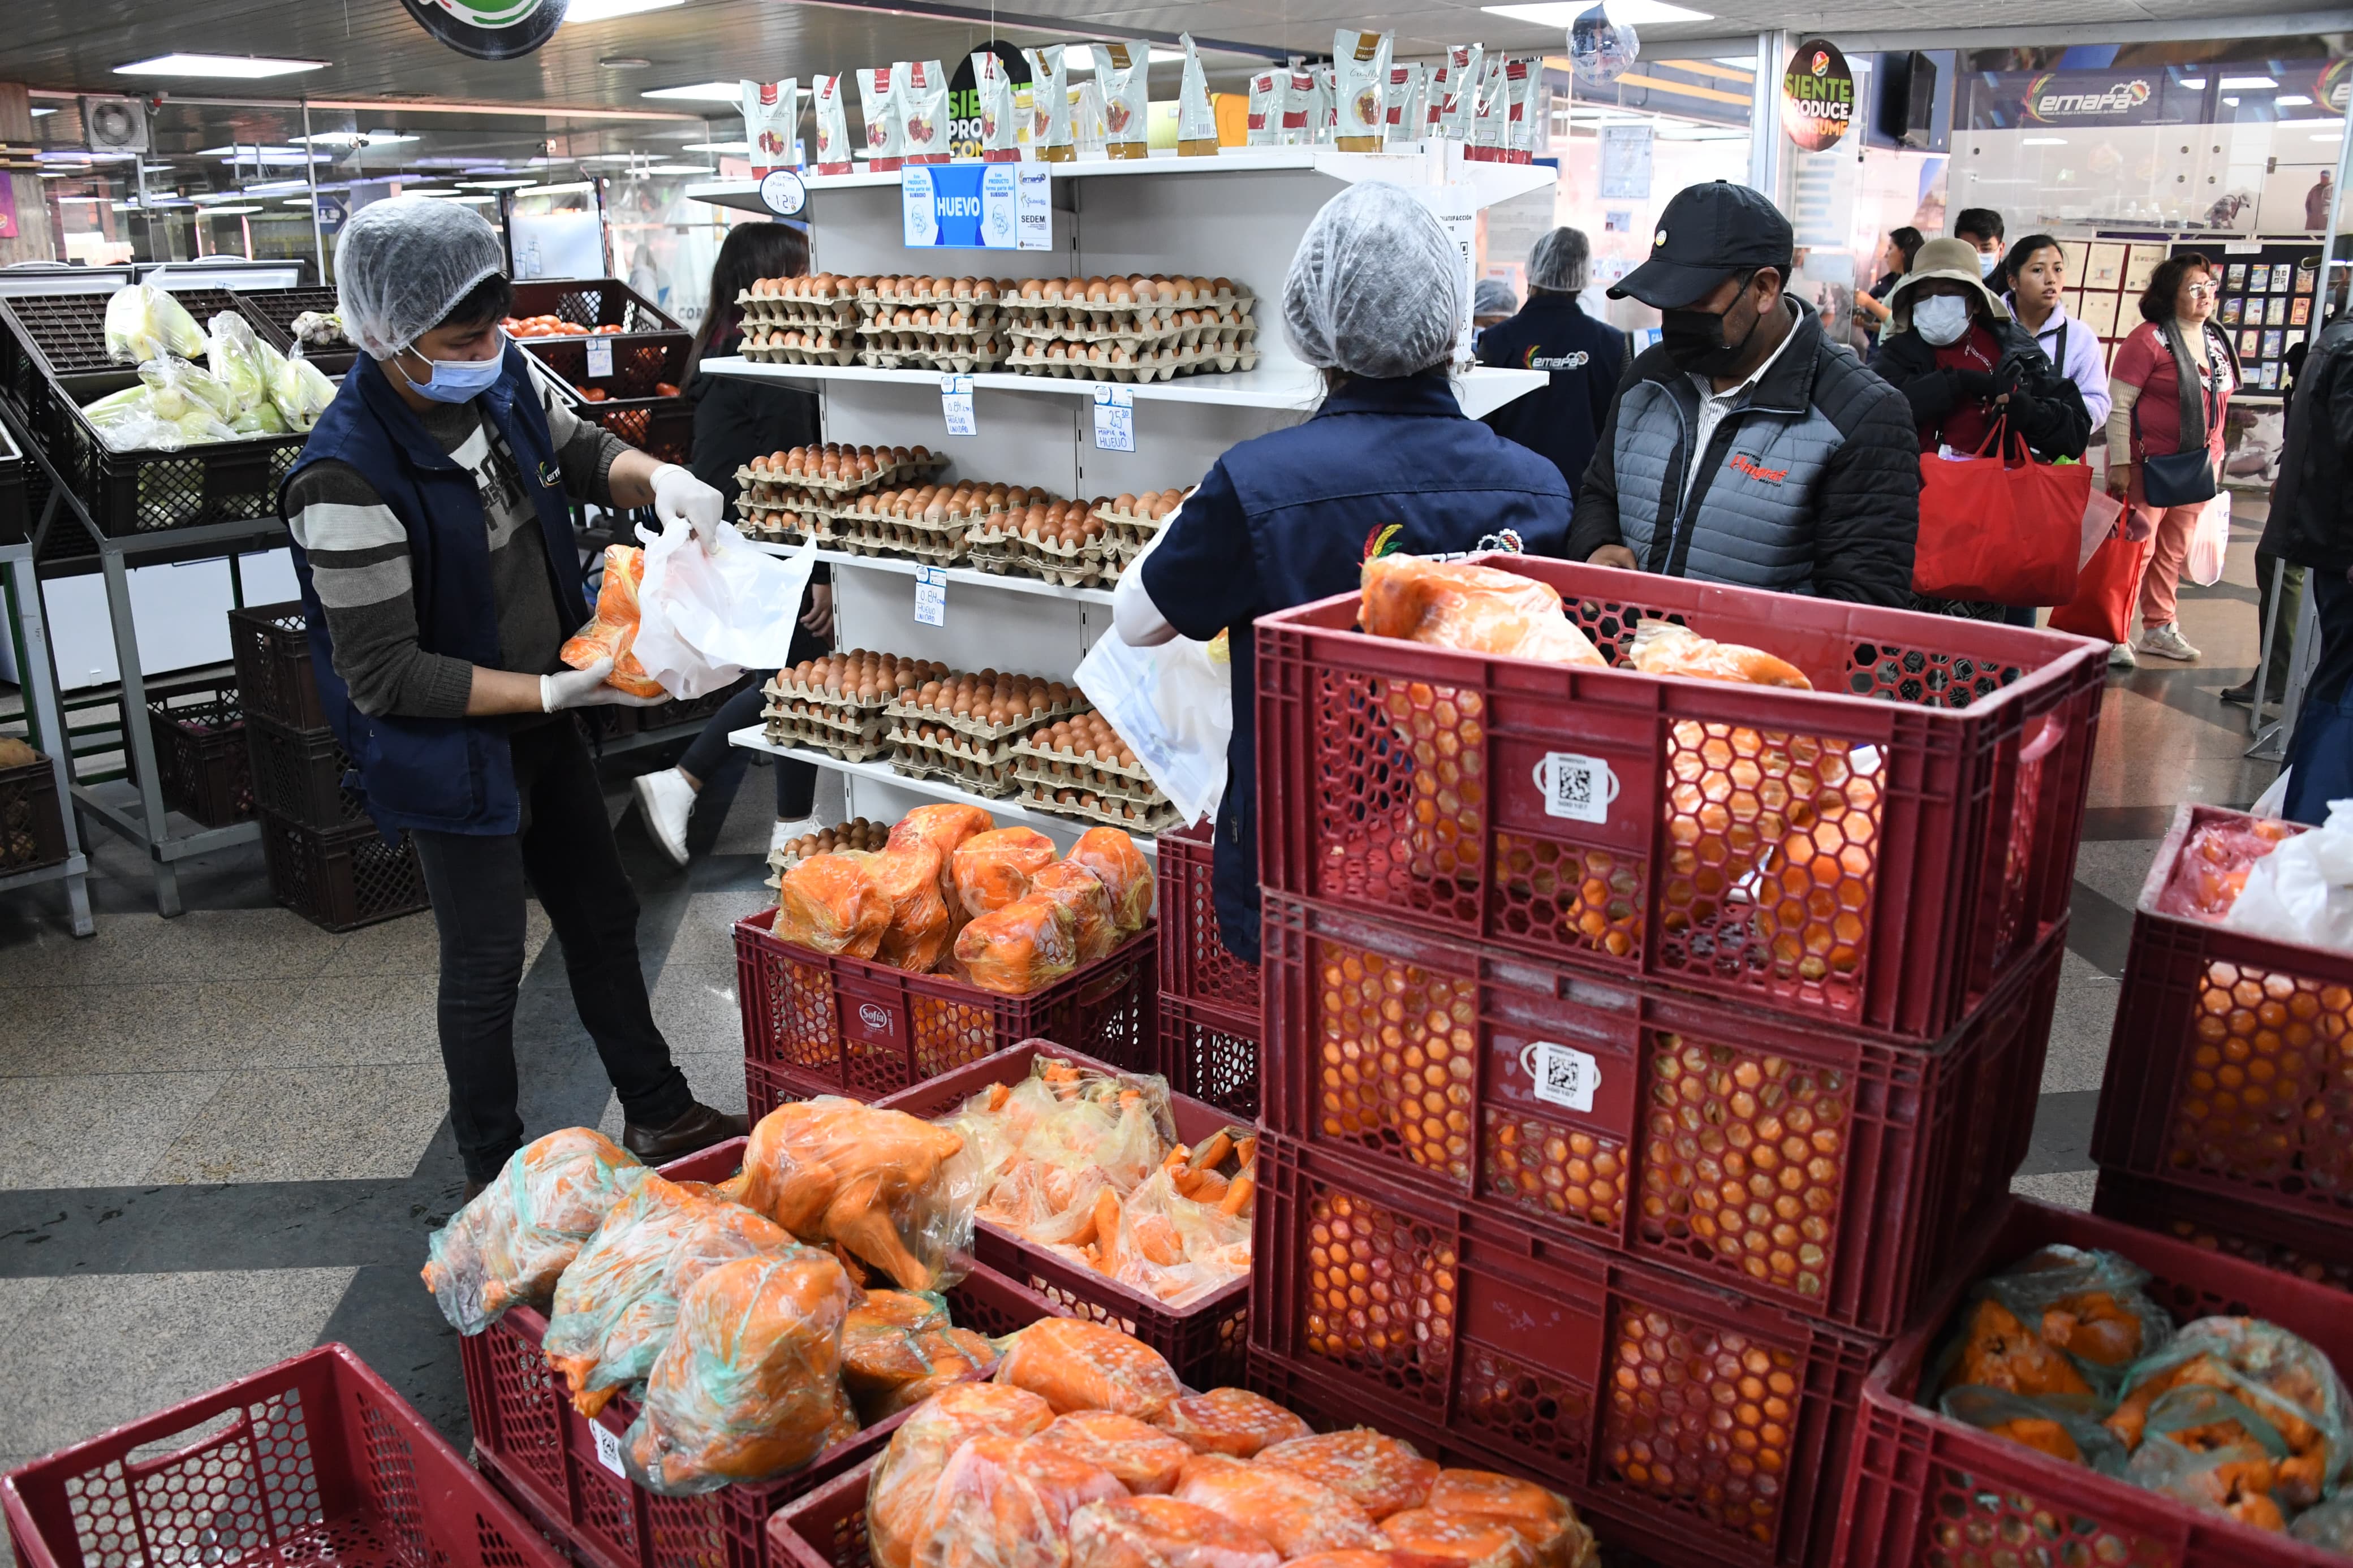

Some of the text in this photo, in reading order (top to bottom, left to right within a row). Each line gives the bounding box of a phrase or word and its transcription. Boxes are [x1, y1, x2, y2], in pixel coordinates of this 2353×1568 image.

[2039, 93, 2132, 111] emapa
[937, 197, 980, 217] HUEVO
[1532, 357, 1579, 367] emapa
